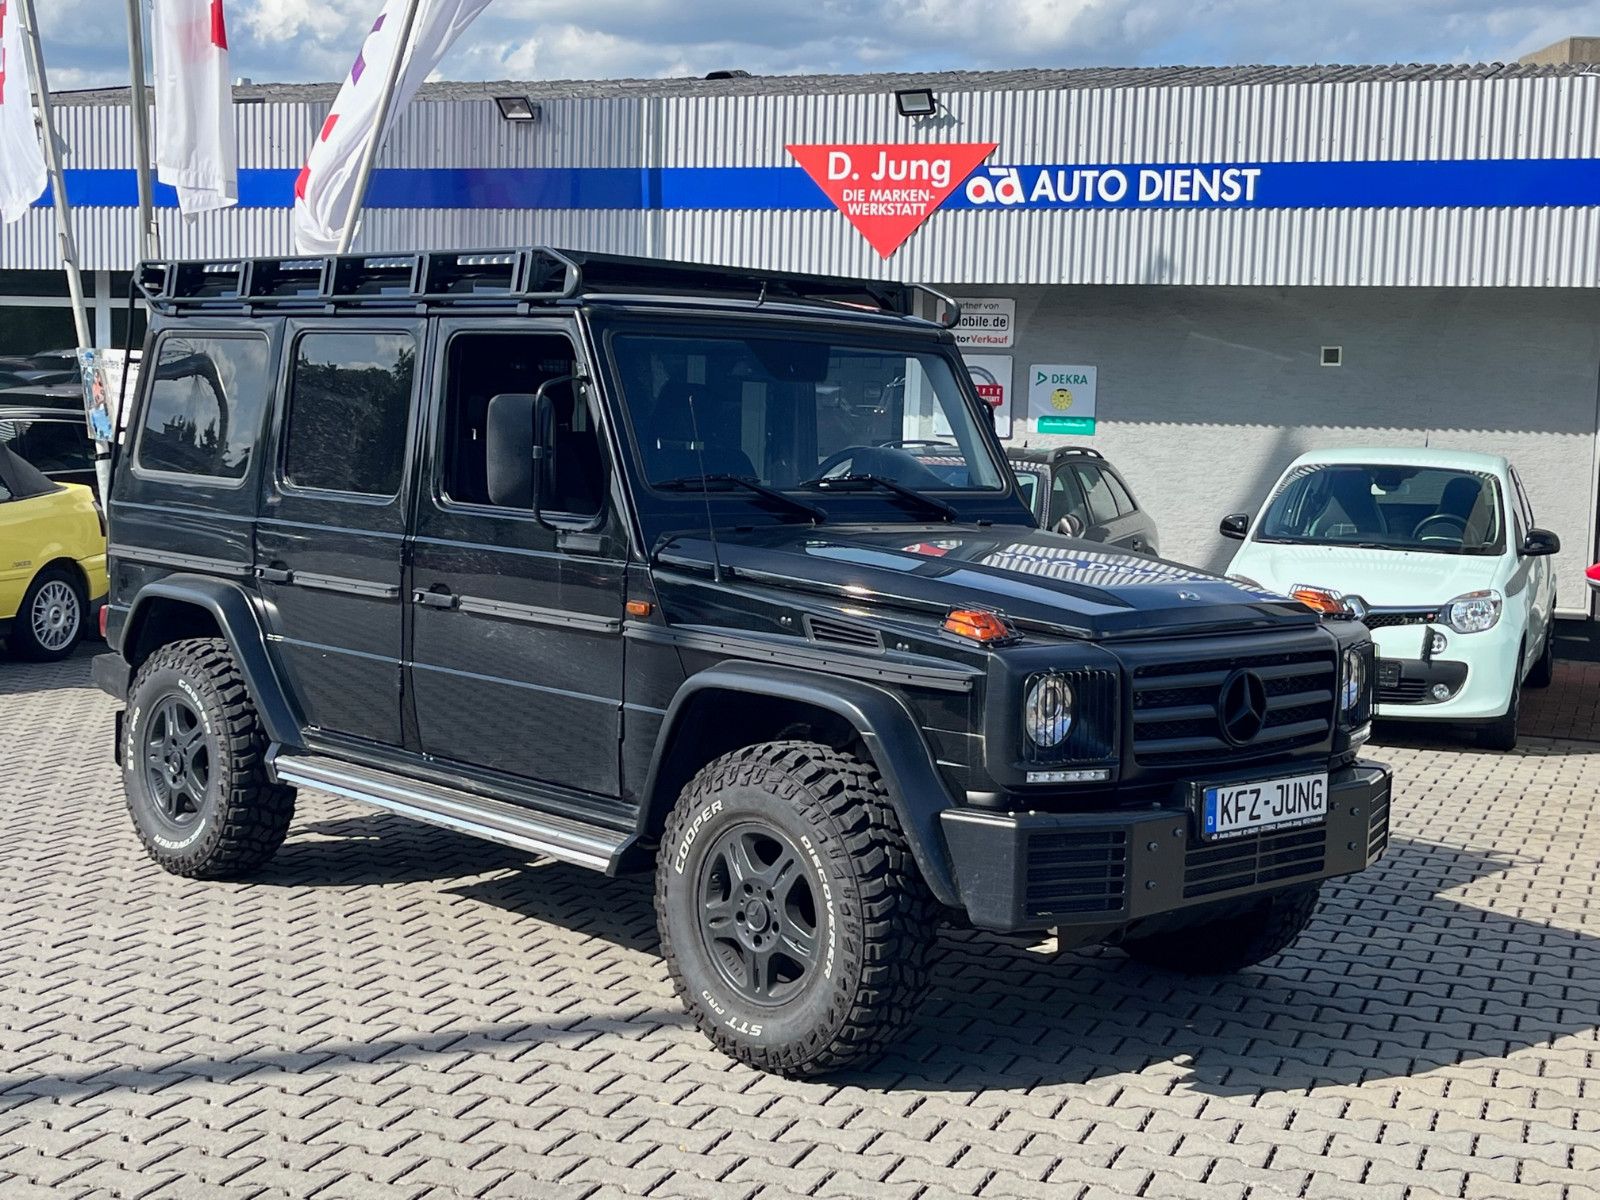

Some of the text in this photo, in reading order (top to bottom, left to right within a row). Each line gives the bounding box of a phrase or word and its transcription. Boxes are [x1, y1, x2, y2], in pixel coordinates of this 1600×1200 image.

[827, 151, 951, 188] D. Jung
[1030, 169, 1128, 202] AUTO
[1138, 168, 1261, 202] DIENST
[842, 189, 936, 202] DIE MARKEN-
[847, 203, 928, 216] WERKSTATT
[1051, 374, 1088, 385] DEKRA
[1220, 779, 1323, 826] KFZ-JUNG
[674, 799, 724, 875] COOPER
[1207, 815, 1214, 826] D
[800, 834, 836, 980] DISCOVERER
[702, 990, 763, 1037] STT PRO
